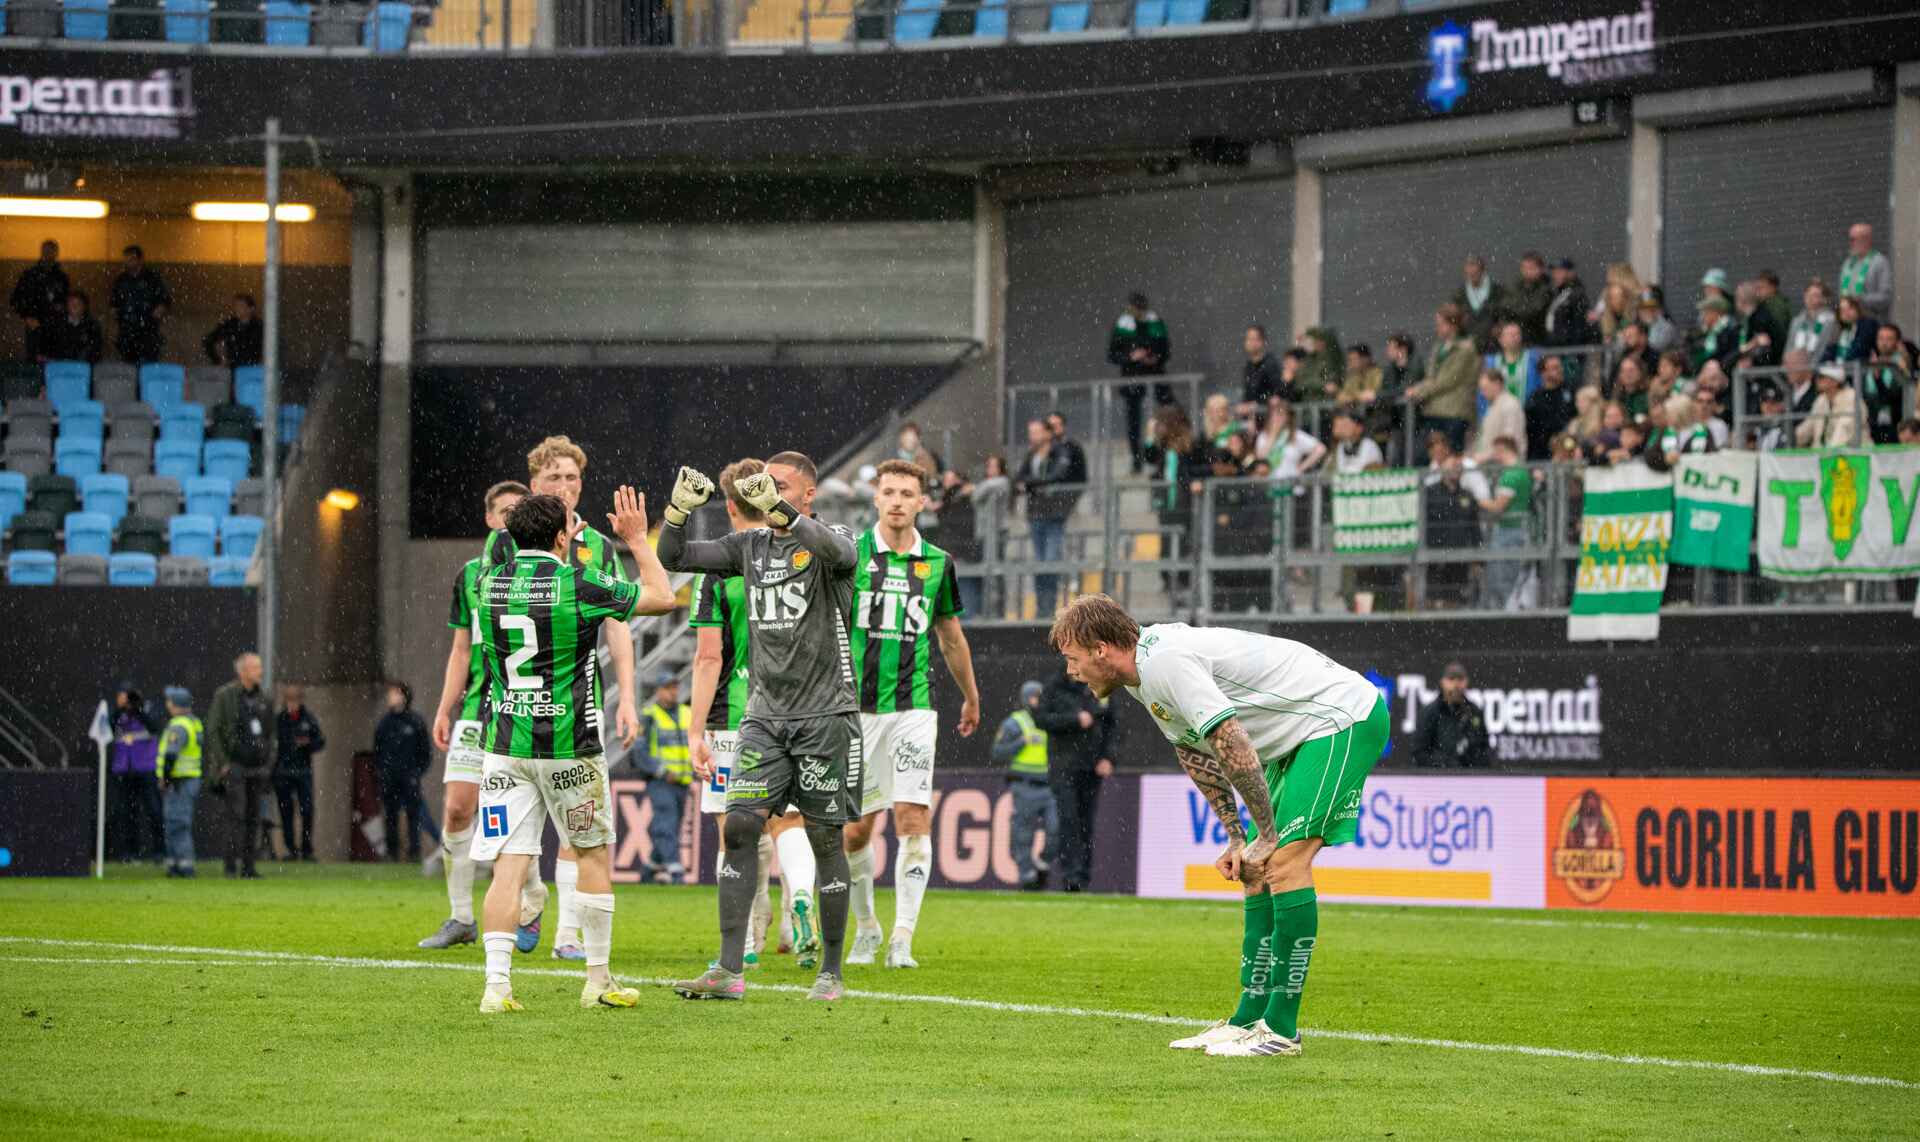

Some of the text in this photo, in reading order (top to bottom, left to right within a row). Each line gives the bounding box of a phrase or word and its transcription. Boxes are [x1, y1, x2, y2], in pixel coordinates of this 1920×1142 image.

[749, 582, 808, 621] ITS
[856, 591, 930, 634] ITS
[500, 614, 544, 689] 2
[491, 701, 567, 717] WELLNESS
[503, 691, 552, 704] NORDIC
[711, 739, 736, 753] AST
[551, 765, 585, 781] GOOD
[800, 755, 829, 778] Maj
[553, 771, 597, 791] ADVICE
[1635, 807, 1919, 894] GORILLA GLU
[1287, 936, 1317, 994] Clinton
